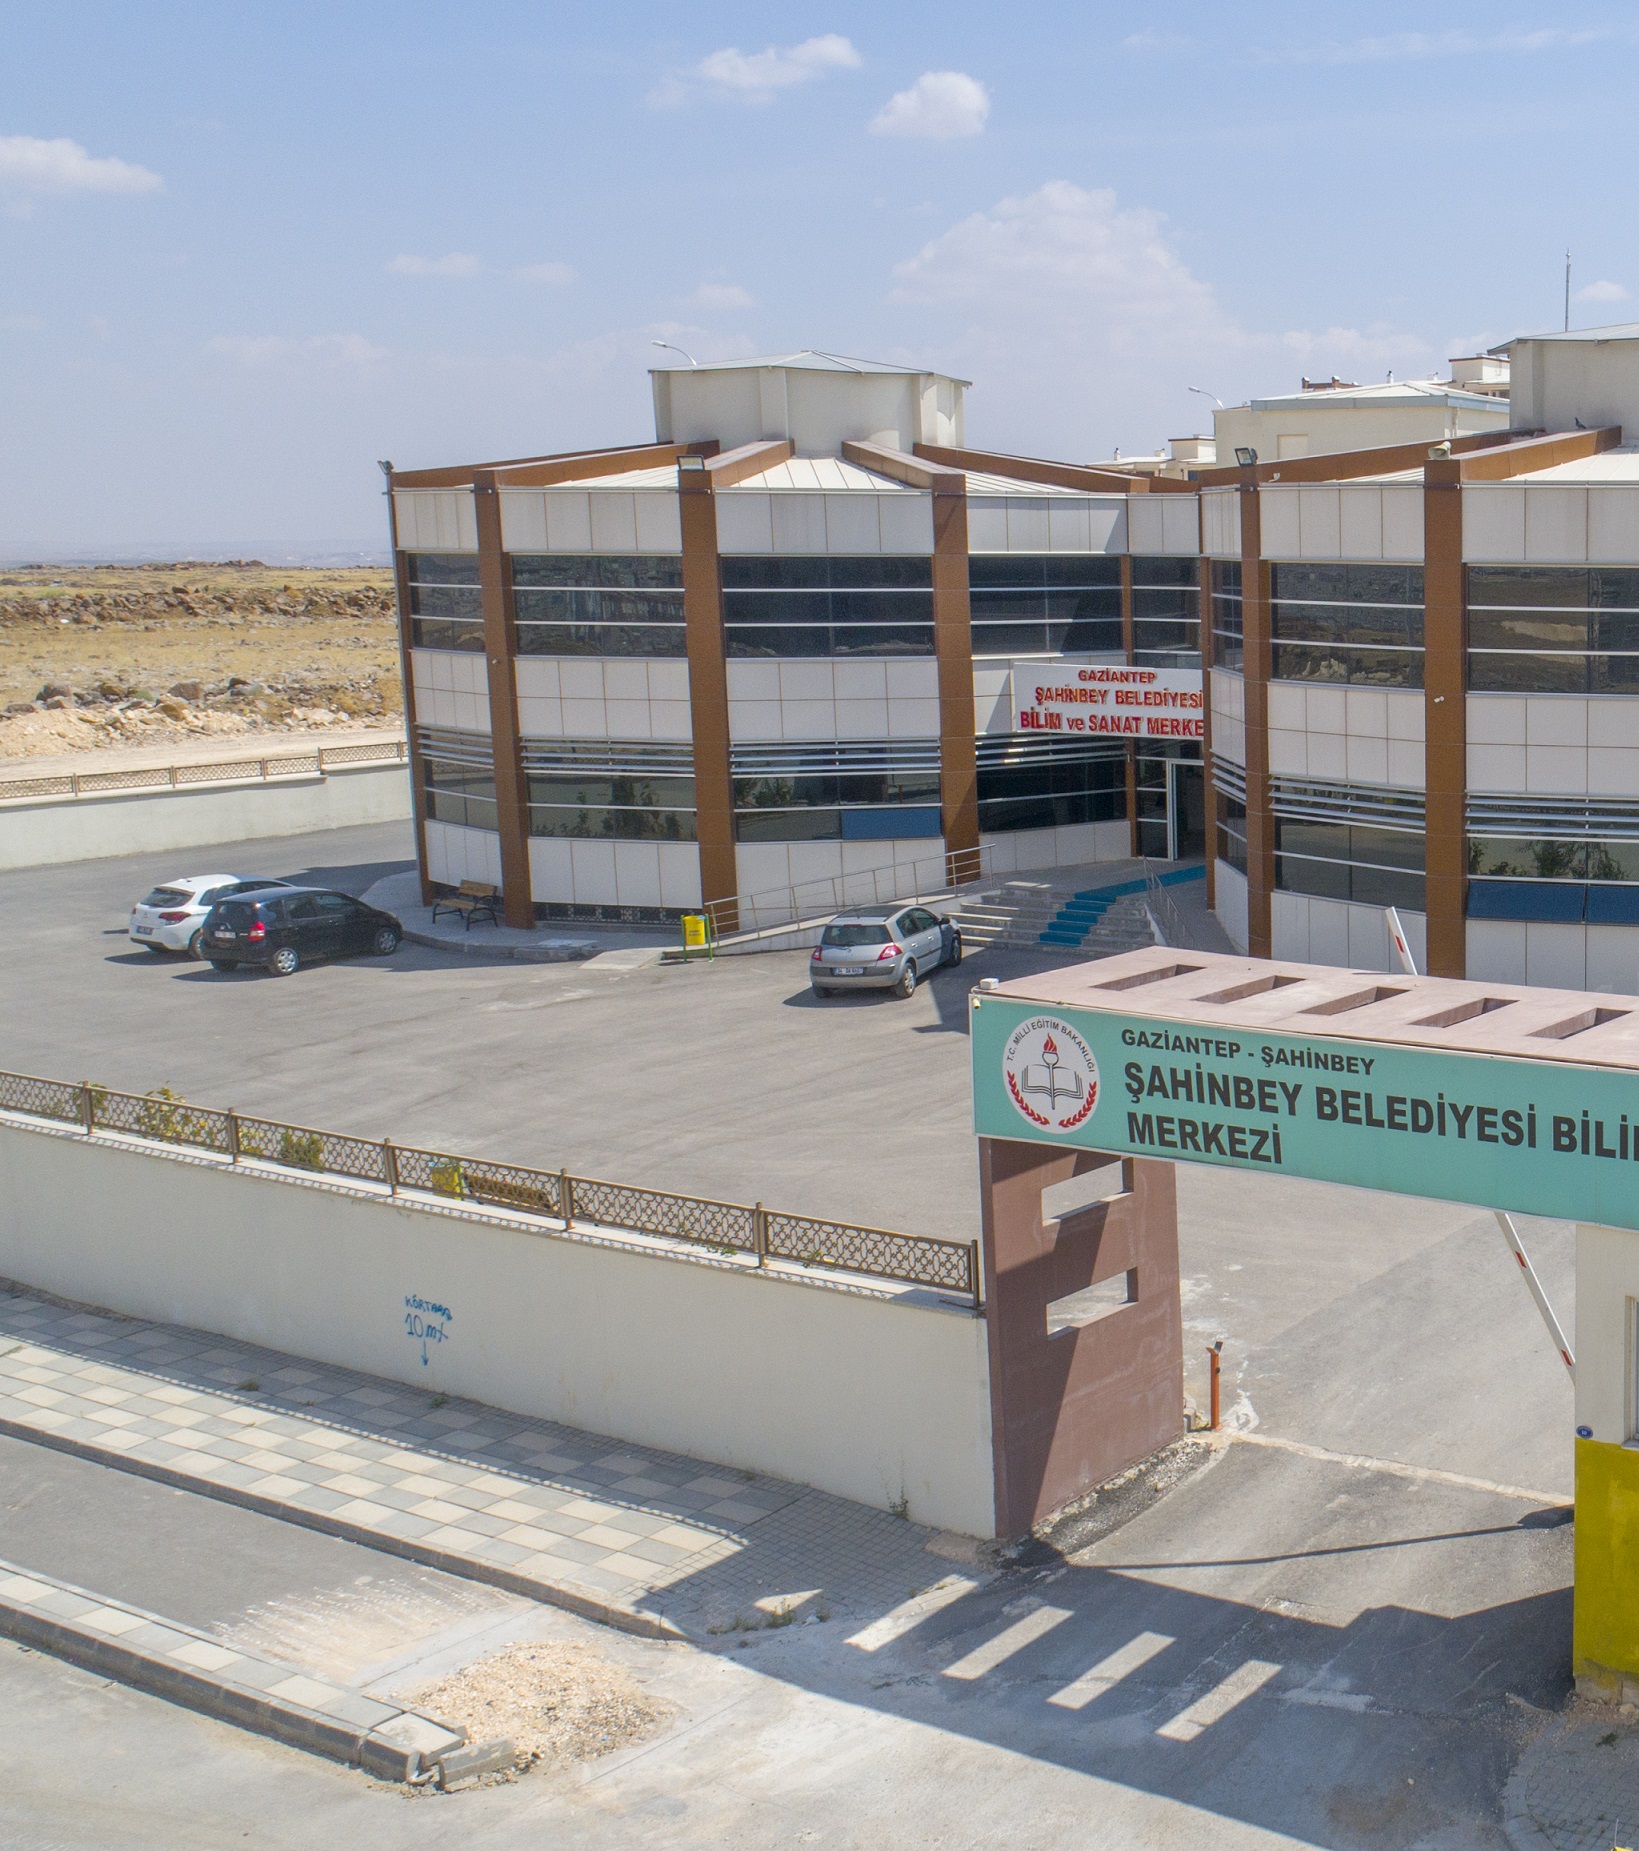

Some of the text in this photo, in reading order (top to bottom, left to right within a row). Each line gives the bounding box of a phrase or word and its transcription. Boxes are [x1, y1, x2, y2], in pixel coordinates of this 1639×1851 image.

[1035, 684, 1203, 708] ŞAHİNBEY BELEDİYESİ
[1078, 668, 1156, 684] GAZİANTEP
[1020, 706, 1204, 737] BİLİM ve SANAT MERKE
[1013, 1023, 1031, 1046] MİLLİ
[1031, 1018, 1060, 1031] EĞİTİM
[1060, 1026, 1096, 1073] BAKANLIĞI
[1121, 1029, 1241, 1059] GAZİANTEP
[1261, 1046, 1375, 1076] ŞAHİNBEY
[1124, 1062, 1303, 1117] ŞAHİNBEY
[1316, 1086, 1537, 1149] BELEDİYESİ
[1127, 1111, 1282, 1165] MERKEZİ
